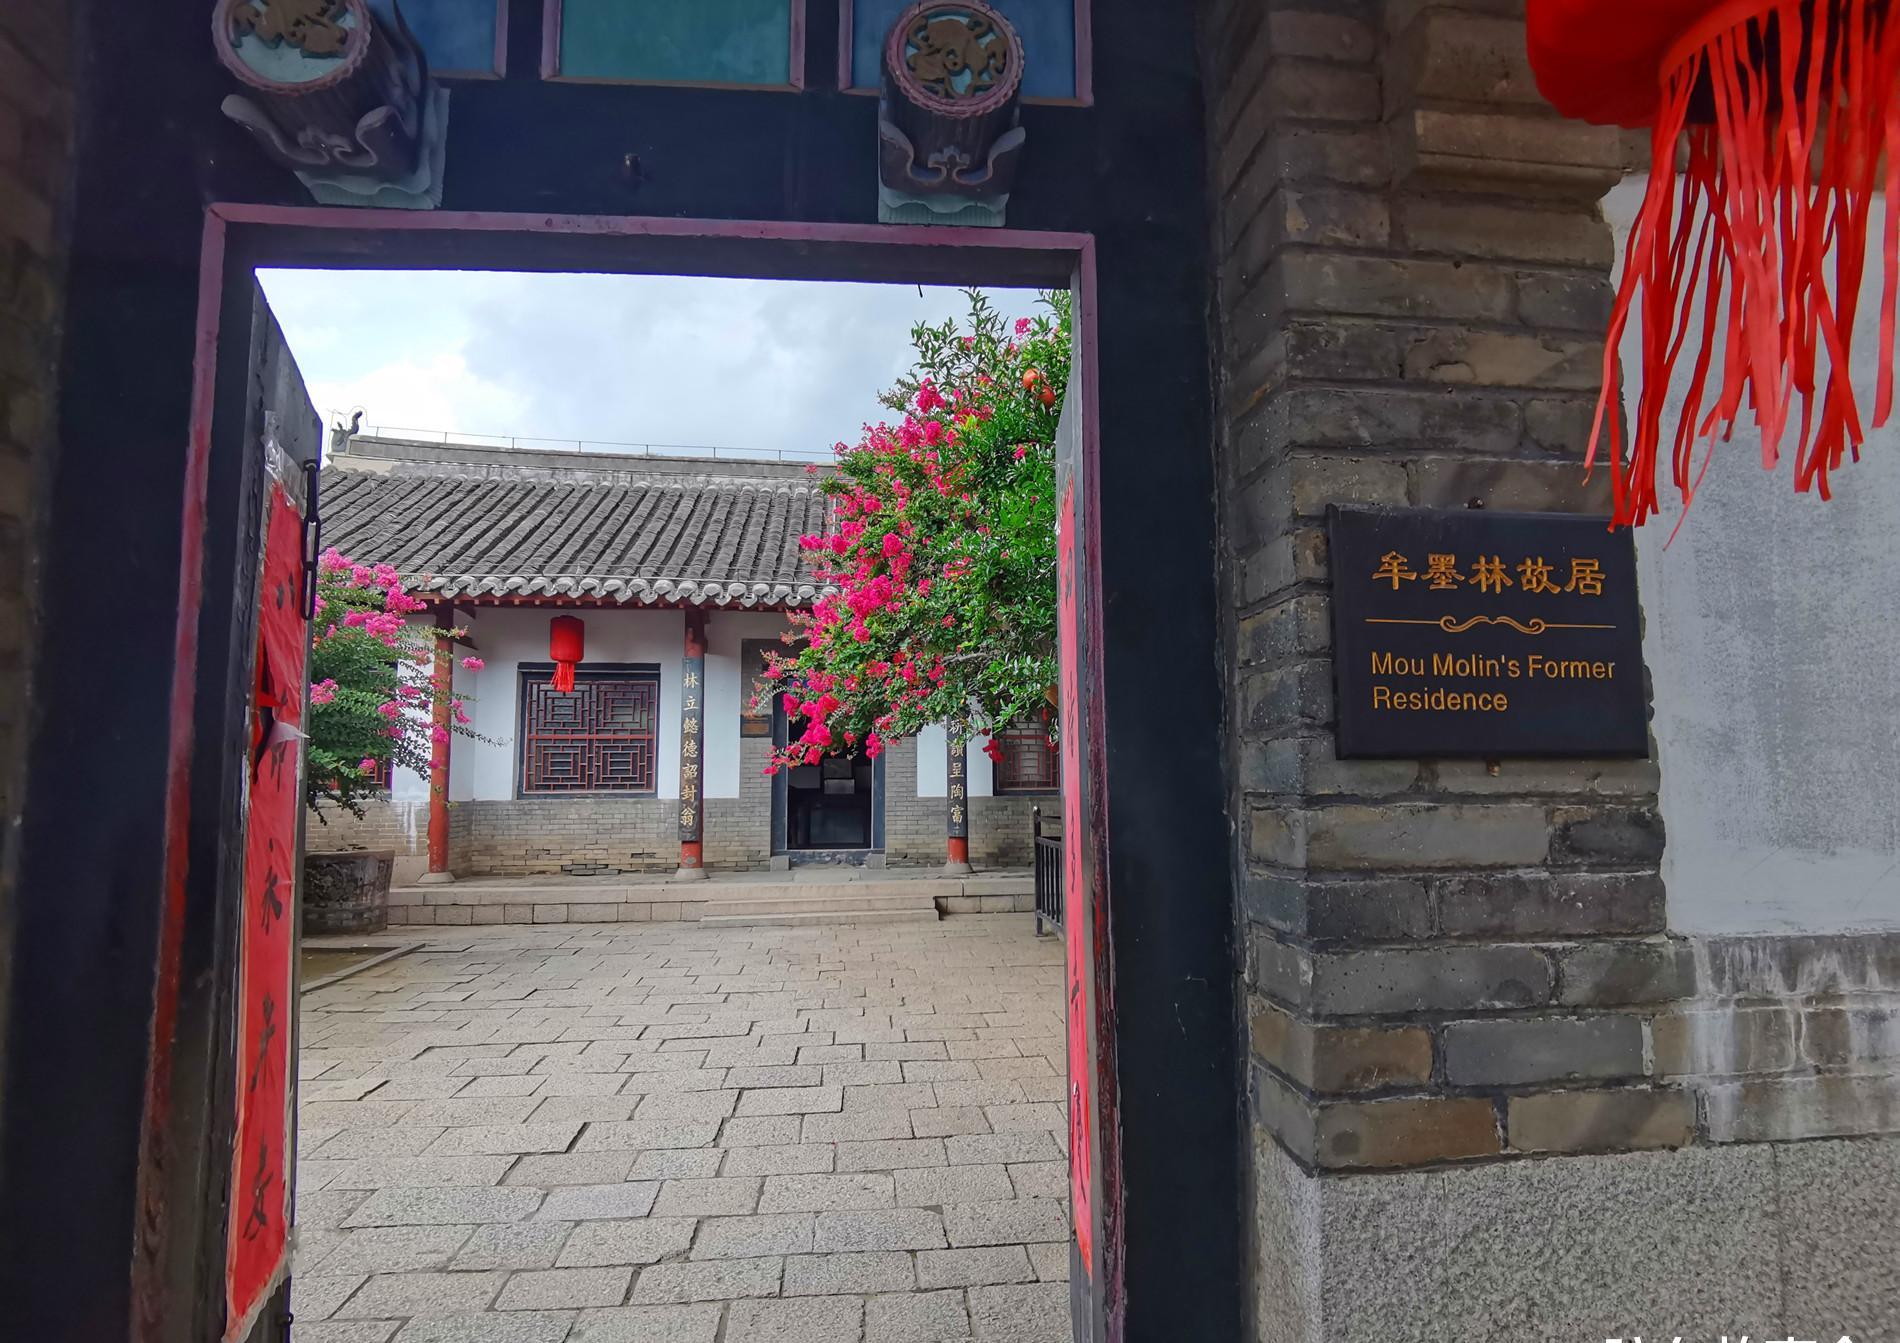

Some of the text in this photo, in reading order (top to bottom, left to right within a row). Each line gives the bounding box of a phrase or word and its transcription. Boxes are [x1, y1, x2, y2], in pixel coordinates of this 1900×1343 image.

[1371, 551, 1606, 595] 牟墨林故居
[1371, 651, 1615, 679] Mou Molin's Former
[1372, 686, 1508, 712] Residence
